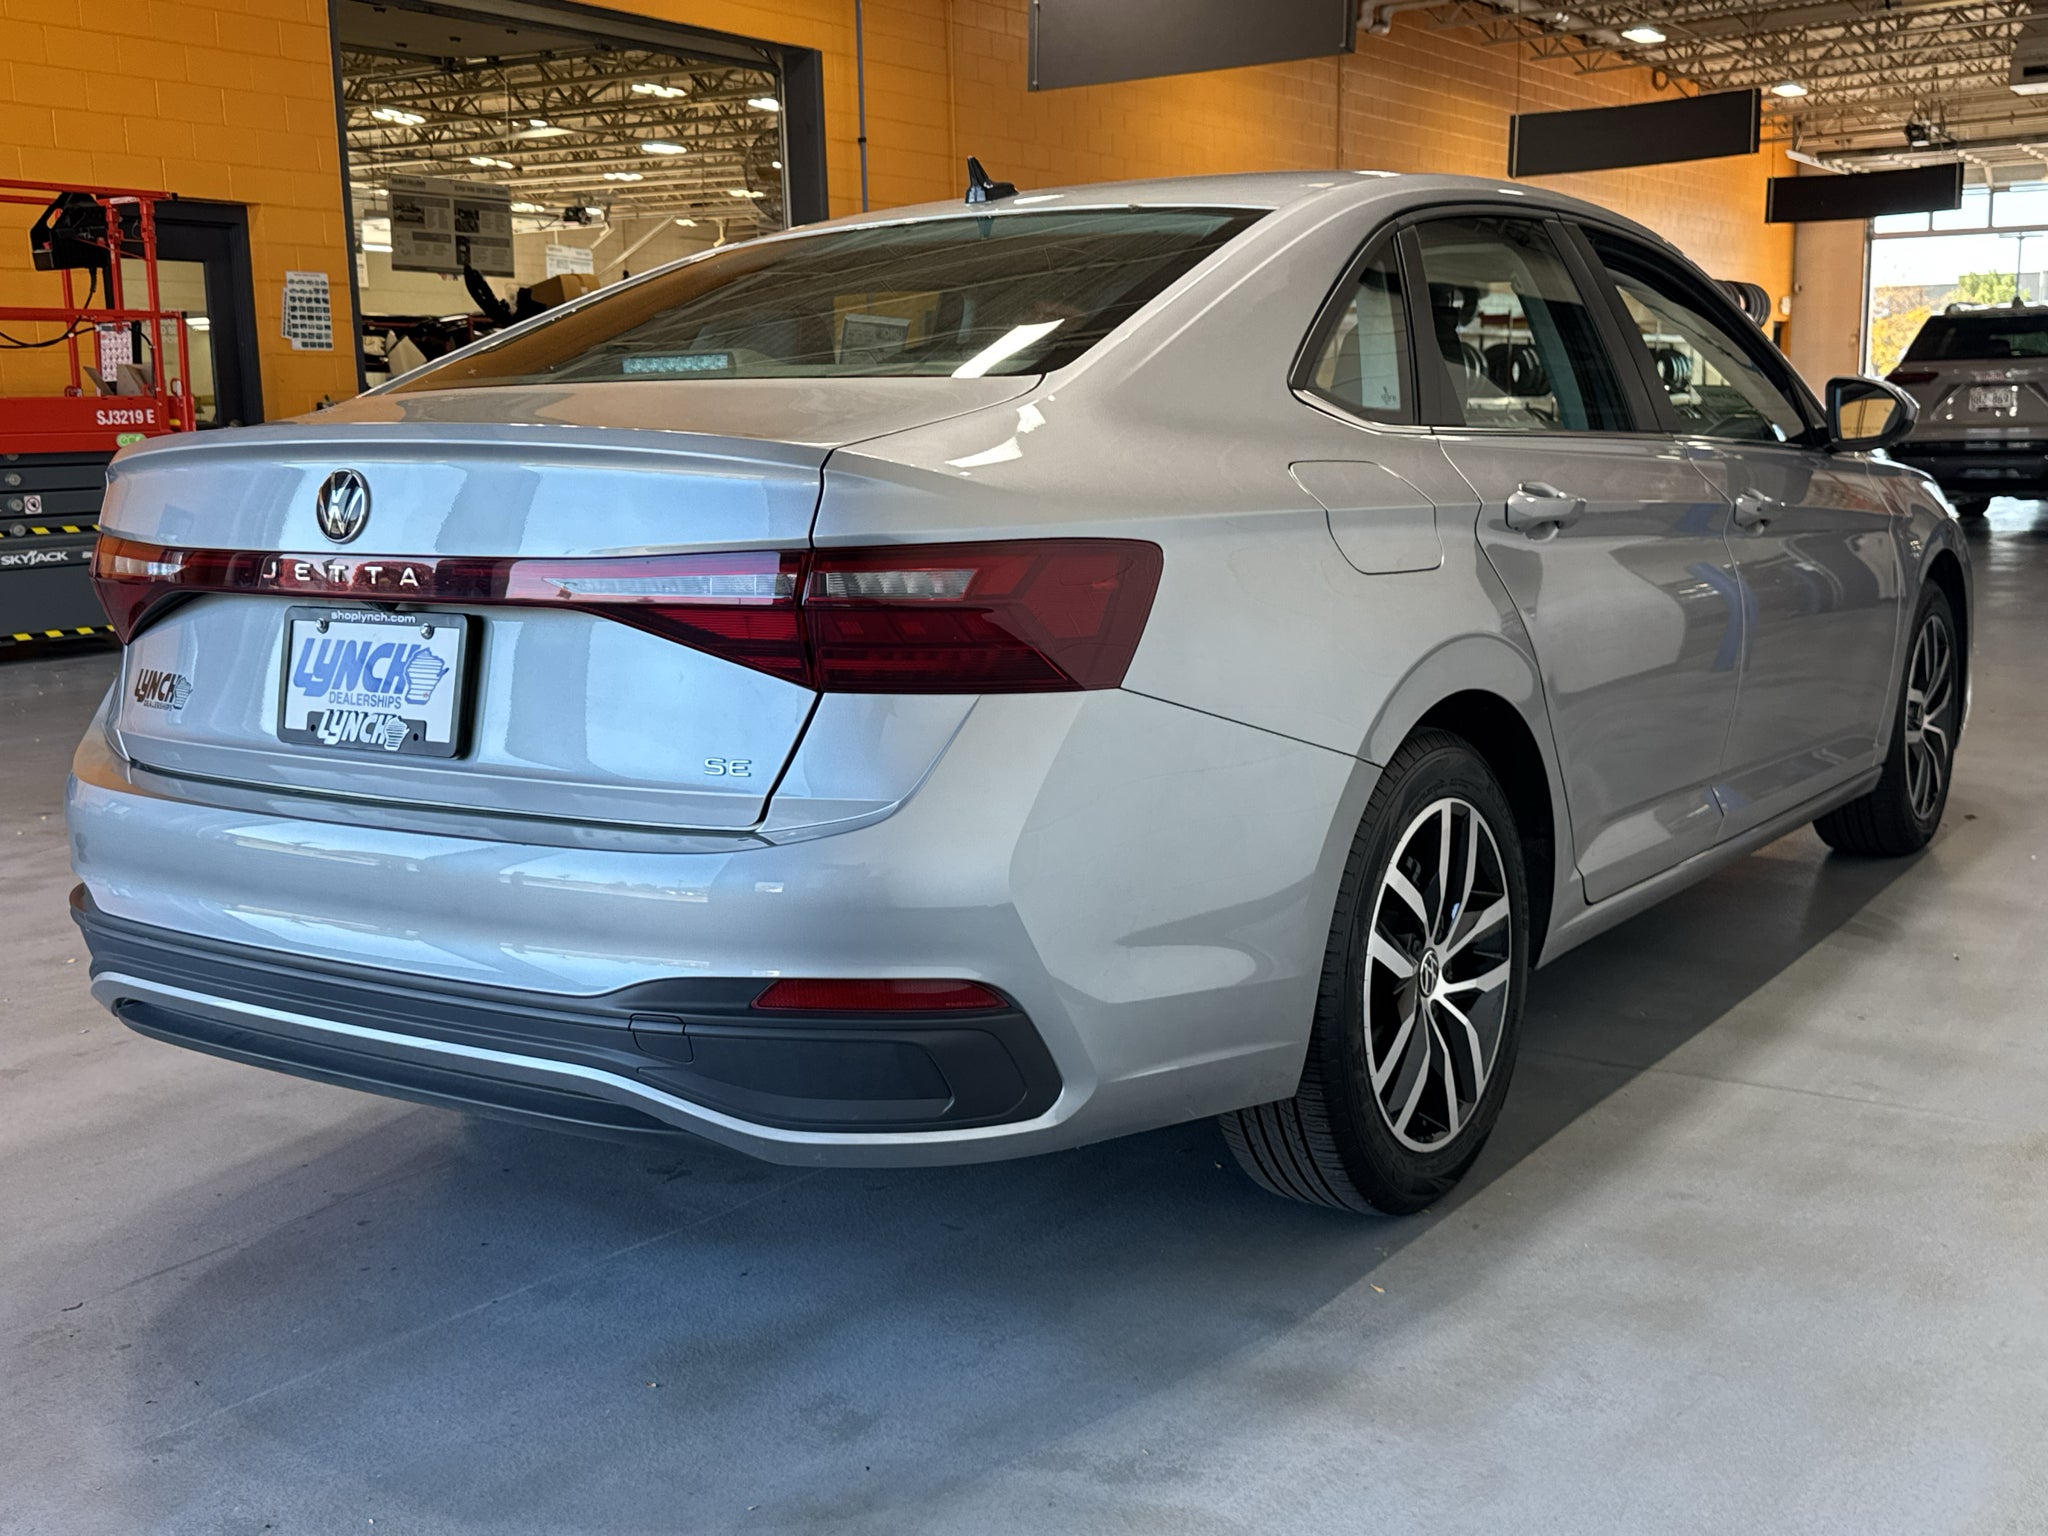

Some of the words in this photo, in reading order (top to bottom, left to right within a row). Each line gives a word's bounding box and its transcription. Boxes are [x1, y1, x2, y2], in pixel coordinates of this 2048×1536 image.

[96, 409, 144, 425] SJ3219
[145, 408, 156, 424] E
[1, 550, 68, 565] SKYJACK
[263, 561, 419, 586] JETTA
[331, 610, 416, 624] shoplynch.com
[293, 637, 421, 697] LYNCH
[134, 668, 182, 703] LYNCH
[329, 690, 402, 710] DEALERSHIPS
[316, 708, 395, 745] LYNCH
[703, 757, 752, 777] SE
